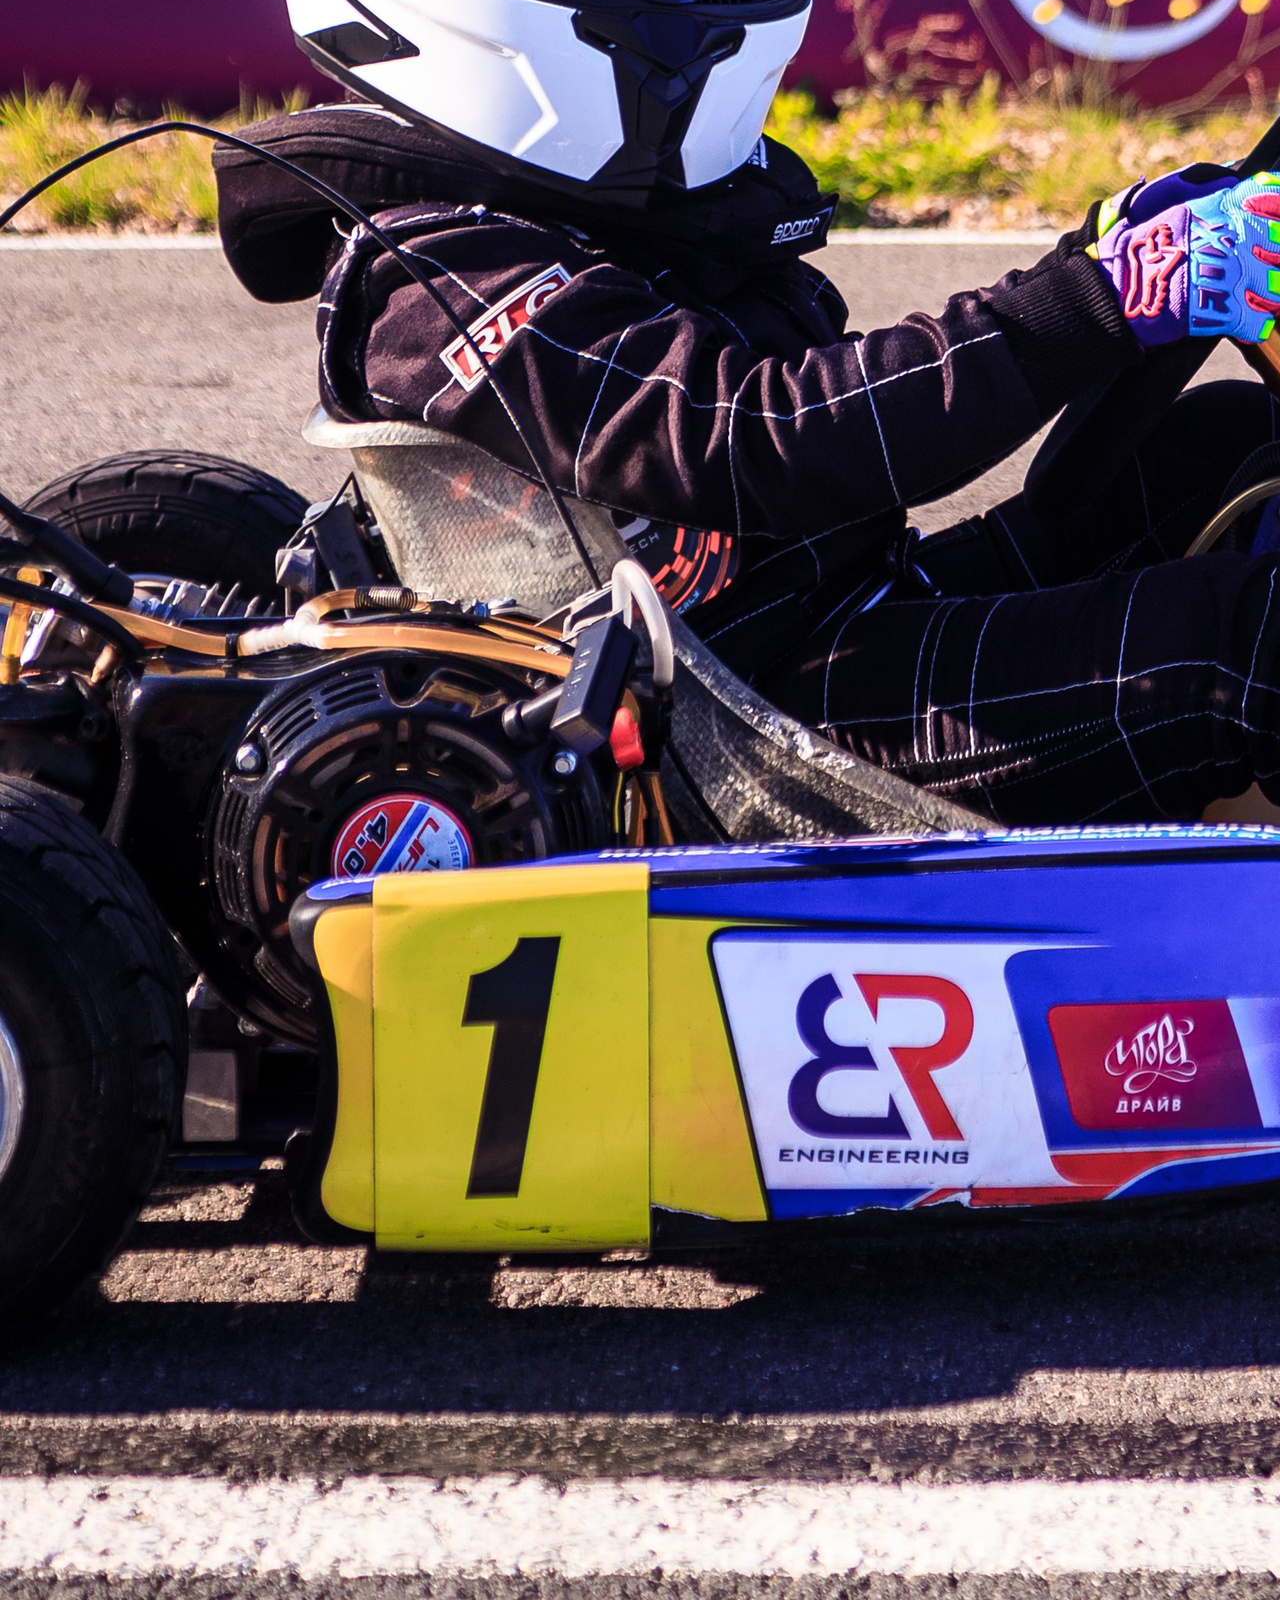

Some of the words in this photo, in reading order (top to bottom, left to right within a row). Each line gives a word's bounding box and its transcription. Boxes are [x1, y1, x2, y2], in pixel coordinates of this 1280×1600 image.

[447, 839, 462, 871] ЭЛЕКТ
[461, 937, 562, 1198] 1
[1115, 1096, 1181, 1113] ДРАЙВ
[778, 1148, 970, 1165] ENGINEERING
